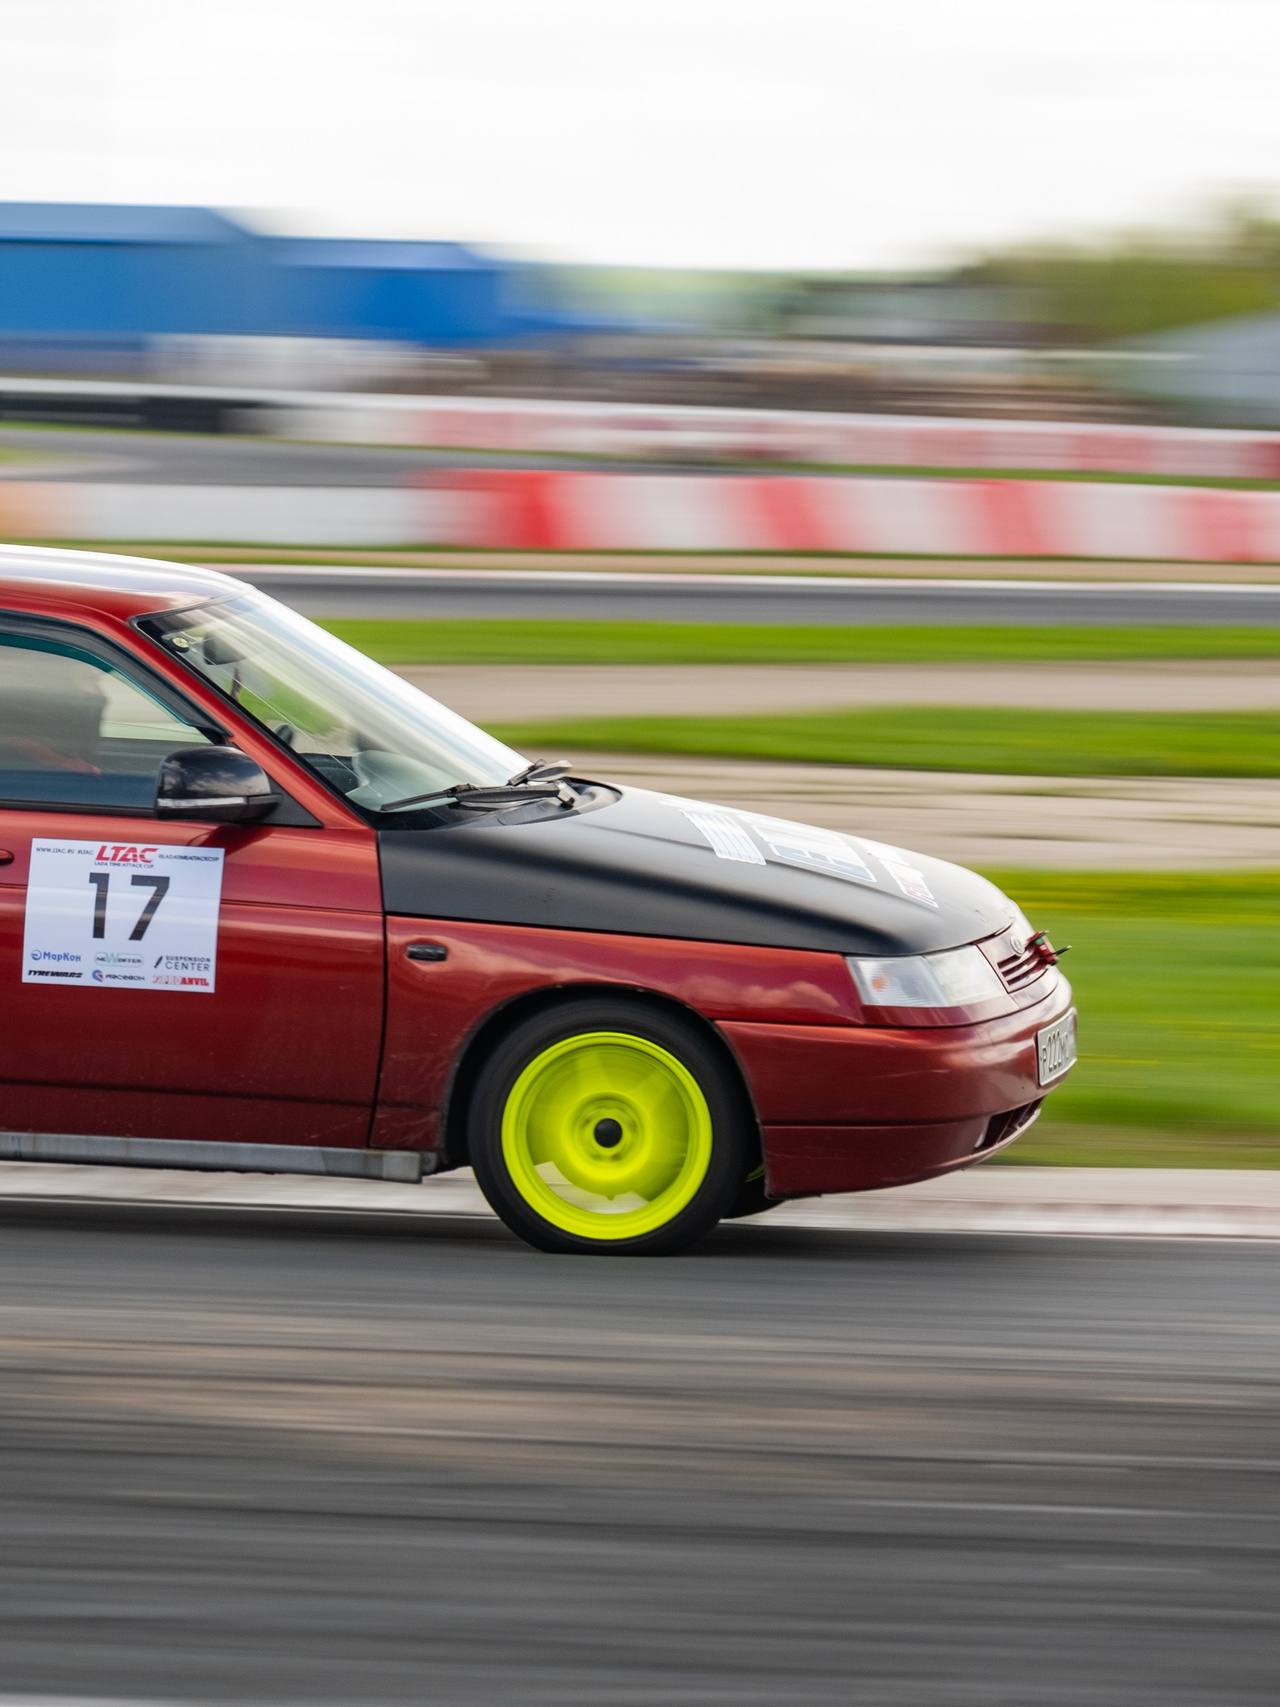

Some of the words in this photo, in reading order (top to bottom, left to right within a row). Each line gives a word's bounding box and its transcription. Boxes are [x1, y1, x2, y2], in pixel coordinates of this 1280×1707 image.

[95, 845, 159, 864] LTAC
[89, 872, 170, 941] 17
[165, 961, 210, 971] CENTER
[27, 969, 84, 978] TYREWARS
